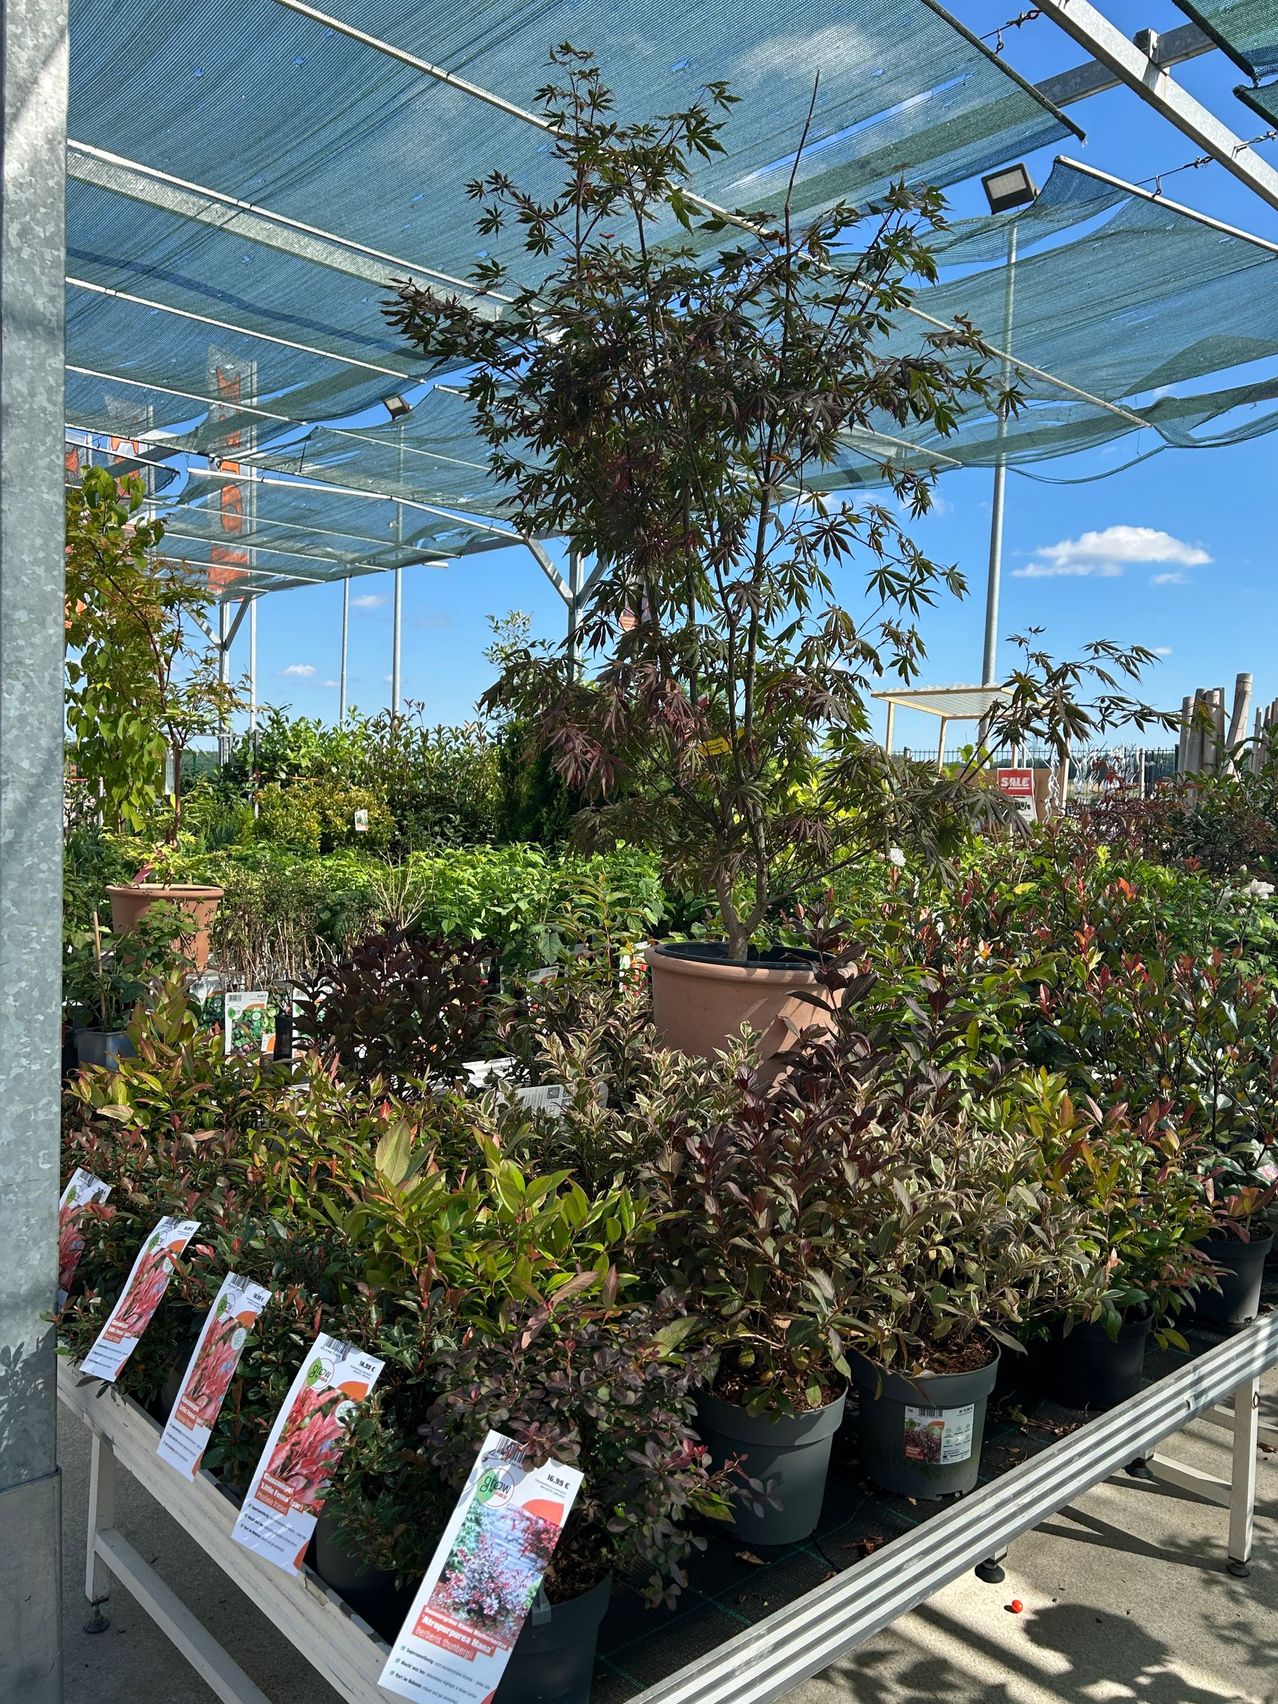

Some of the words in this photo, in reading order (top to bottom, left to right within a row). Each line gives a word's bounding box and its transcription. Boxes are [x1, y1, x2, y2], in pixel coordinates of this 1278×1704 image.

[1001, 777, 1030, 787] SALE
[479, 1474, 511, 1496] grow
[546, 1473, 565, 1487] 16,99
[564, 1481, 571, 1490] €
[414, 1625, 442, 1644] Berberis
[440, 1638, 474, 1661] thunbergii
